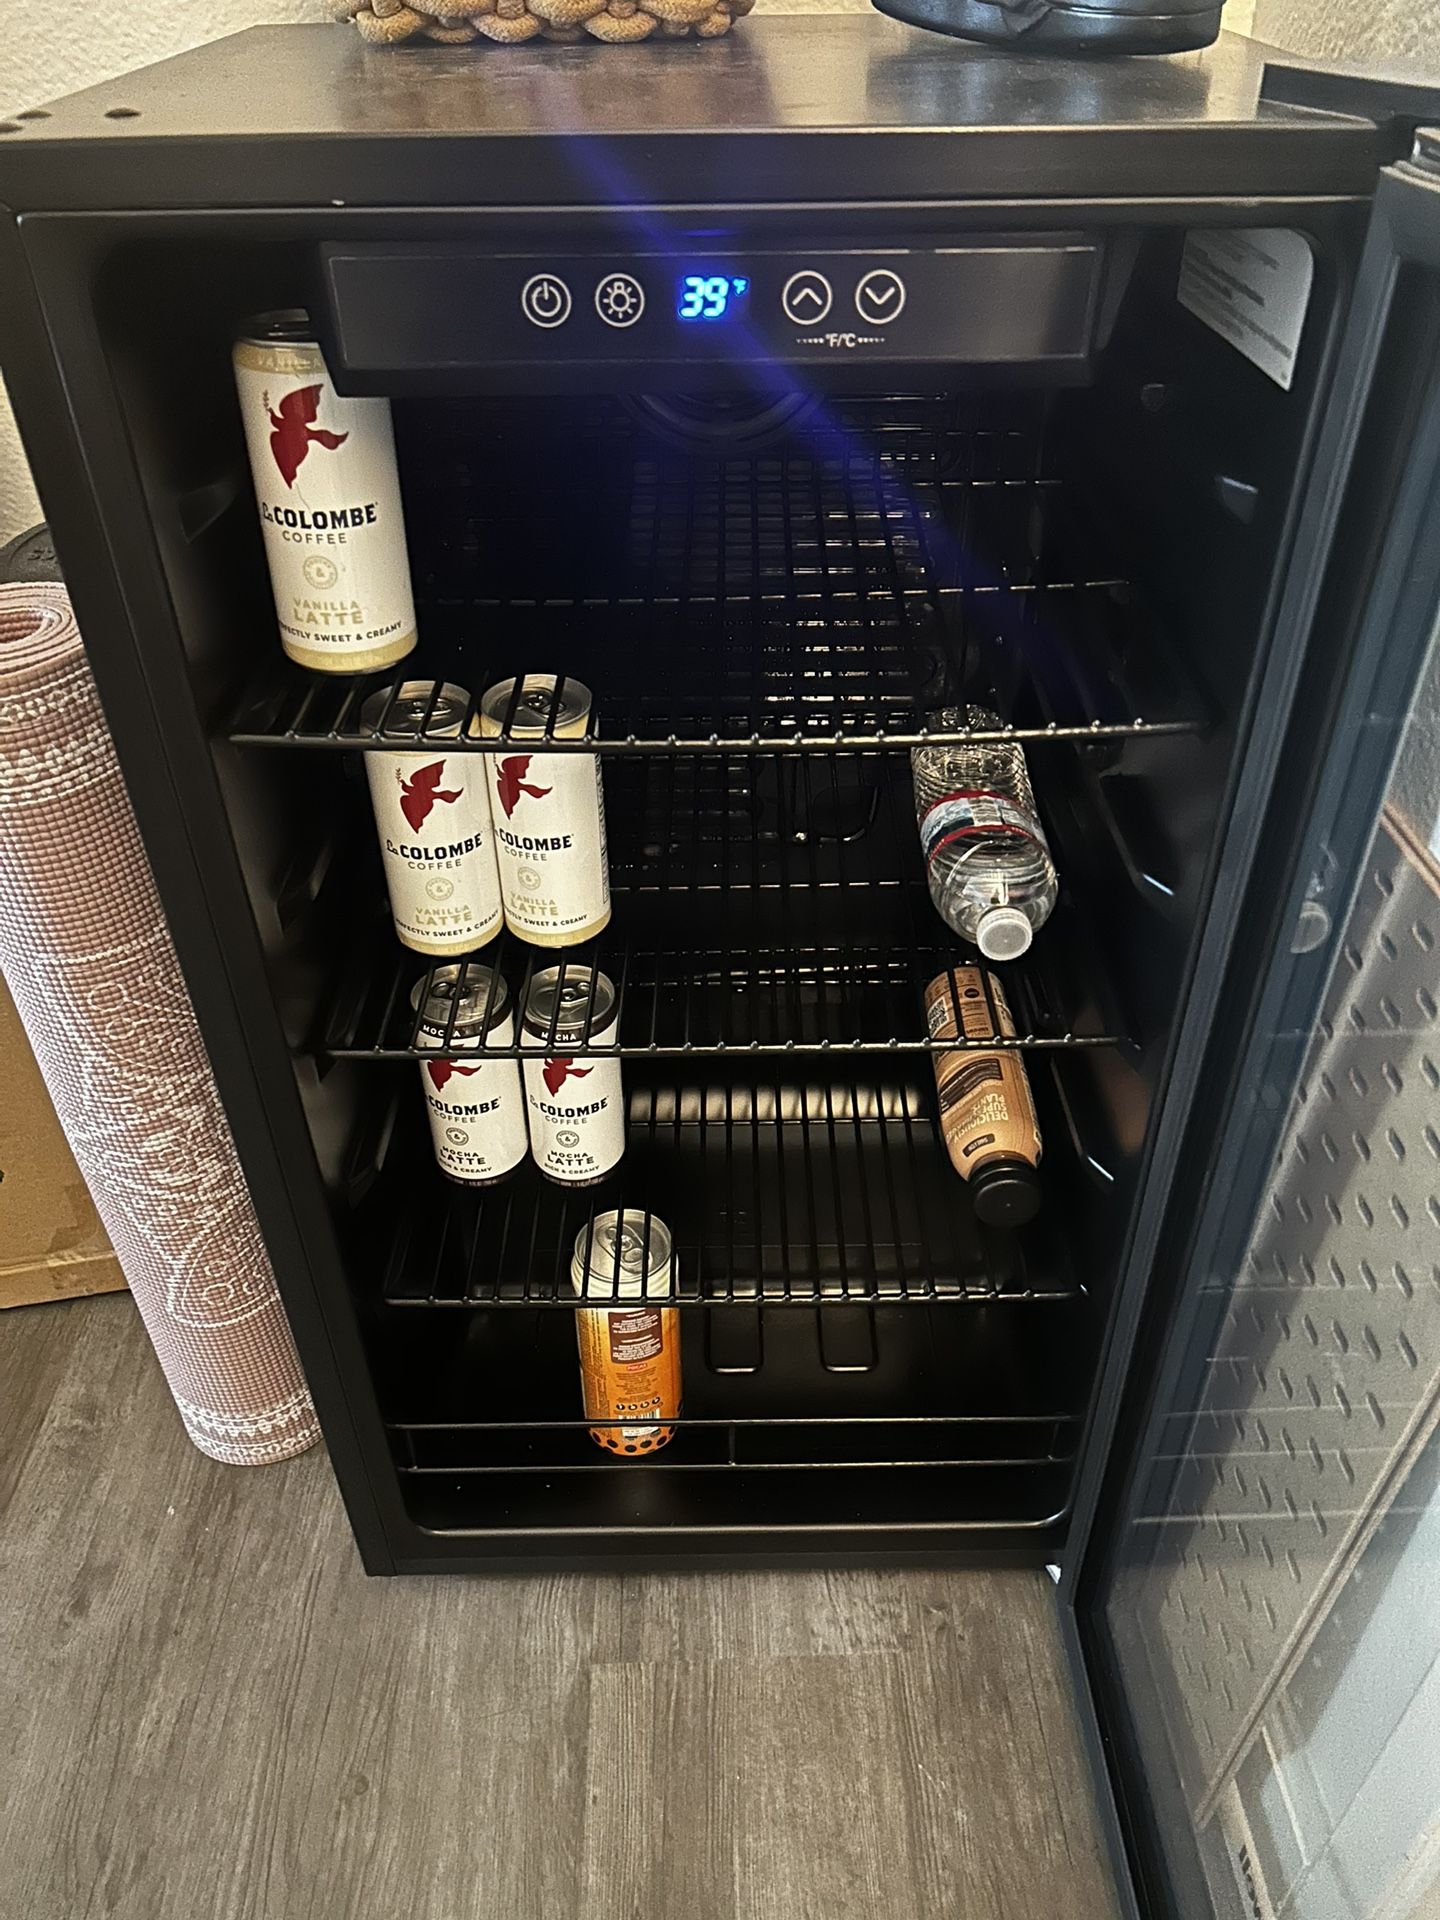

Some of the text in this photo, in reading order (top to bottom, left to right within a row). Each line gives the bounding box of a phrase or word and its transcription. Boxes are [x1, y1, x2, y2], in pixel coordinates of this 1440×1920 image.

[273, 504, 377, 529] COLOMBE
[282, 530, 347, 544] COFFEE
[293, 598, 360, 611] VANILLA
[292, 608, 364, 625] LATTE
[314, 633, 352, 642] SWEET
[356, 633, 363, 641] &
[366, 620, 402, 639] CREAMY
[400, 833, 482, 860] COLOMBE
[500, 828, 572, 851] COLOMBE
[504, 845, 547, 861] COFFEE
[408, 858, 462, 870] COFFEE
[510, 891, 556, 906] VANILLA
[415, 905, 470, 915] VANILLA
[511, 898, 558, 916] LATTE
[415, 911, 473, 926] LATTE
[433, 929, 463, 937] SWEET
[474, 909, 499, 929] CREAMY
[560, 914, 587, 926] CREAMY
[423, 1024, 461, 1037] MOCA
[541, 1031, 577, 1041] MCHA
[428, 1094, 500, 1116] COLOMBE
[540, 1097, 608, 1118] COLOMBE
[434, 1109, 477, 1124] COFFEE
[545, 1115, 588, 1125] COFFEE
[440, 1148, 486, 1165] LATTE
[442, 1145, 479, 1158] MOCHA
[551, 1150, 588, 1159] MOCHA
[547, 1154, 594, 1167] LATTE
[568, 1165, 599, 1174] CREAMY
